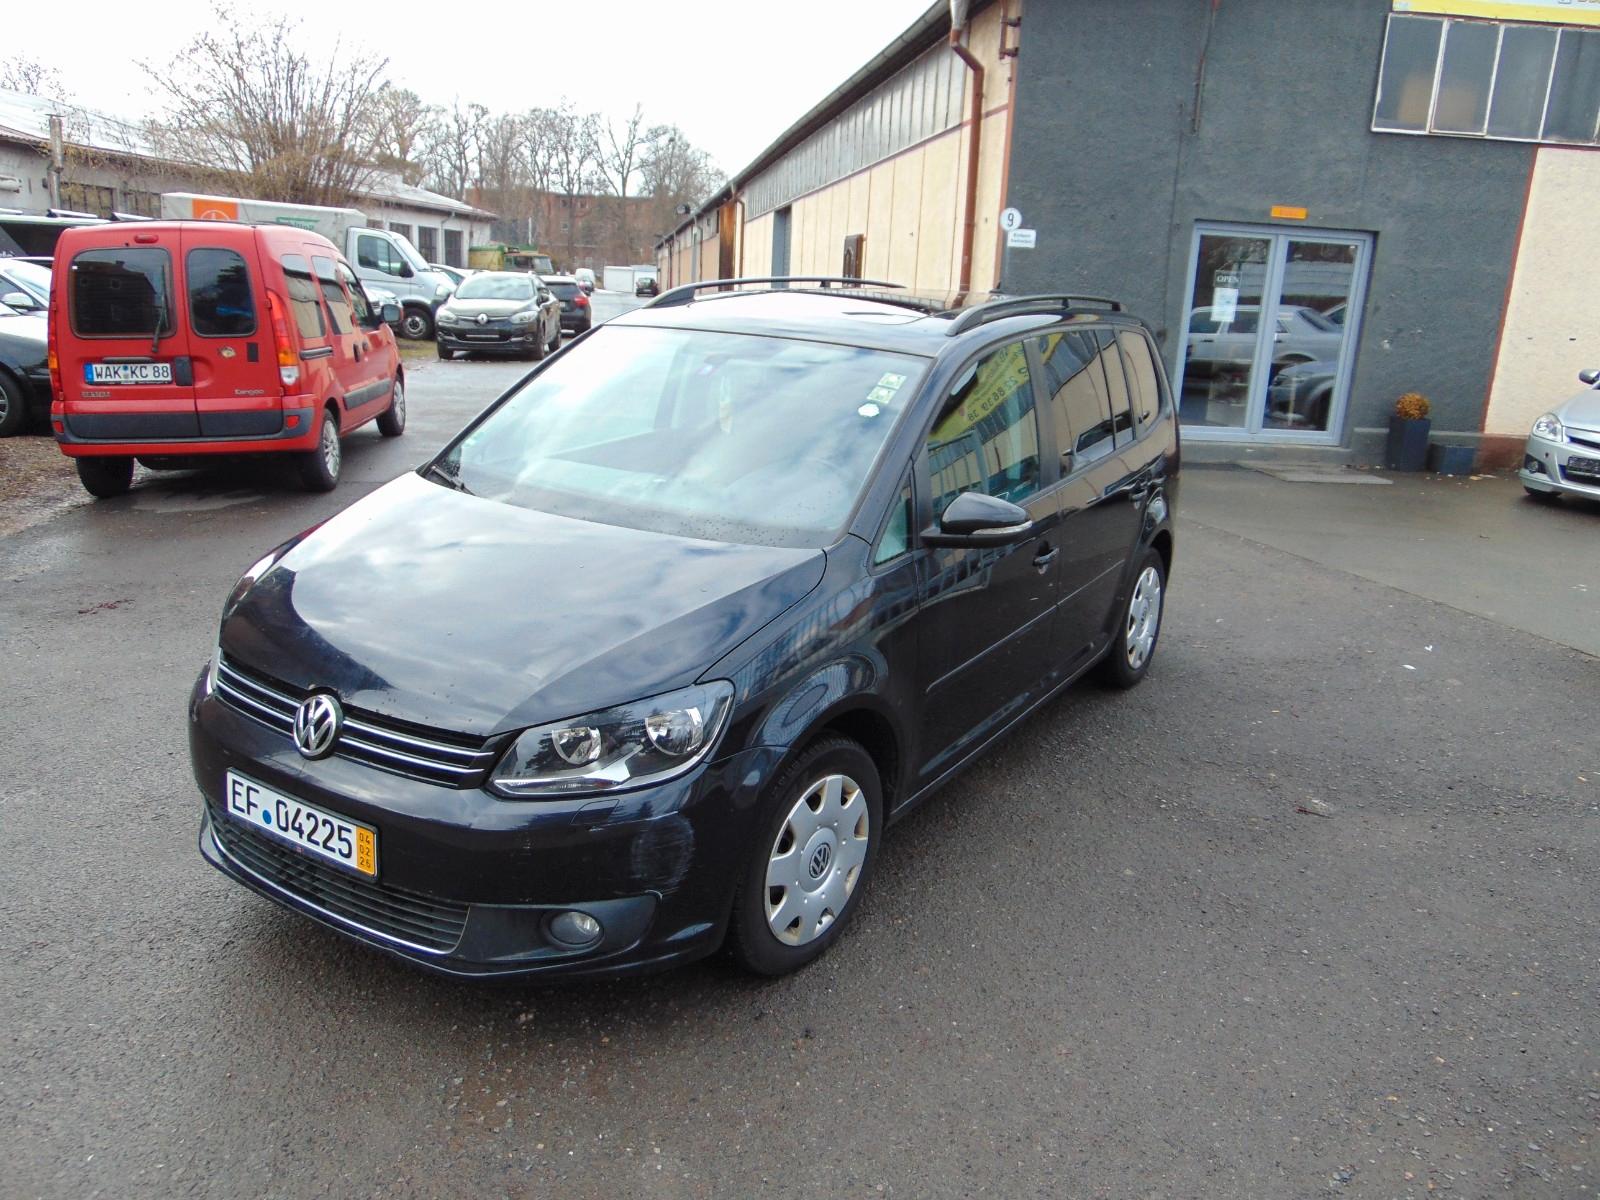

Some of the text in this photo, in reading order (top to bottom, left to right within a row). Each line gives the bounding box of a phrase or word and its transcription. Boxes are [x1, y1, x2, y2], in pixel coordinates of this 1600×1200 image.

[1008, 213, 1014, 227] 9
[94, 366, 169, 379] WAK KC 88
[294, 694, 336, 756] VW
[231, 778, 353, 859] EF 04225
[359, 832, 370, 845] 04
[359, 845, 370, 856] 02
[359, 857, 371, 868] 26
